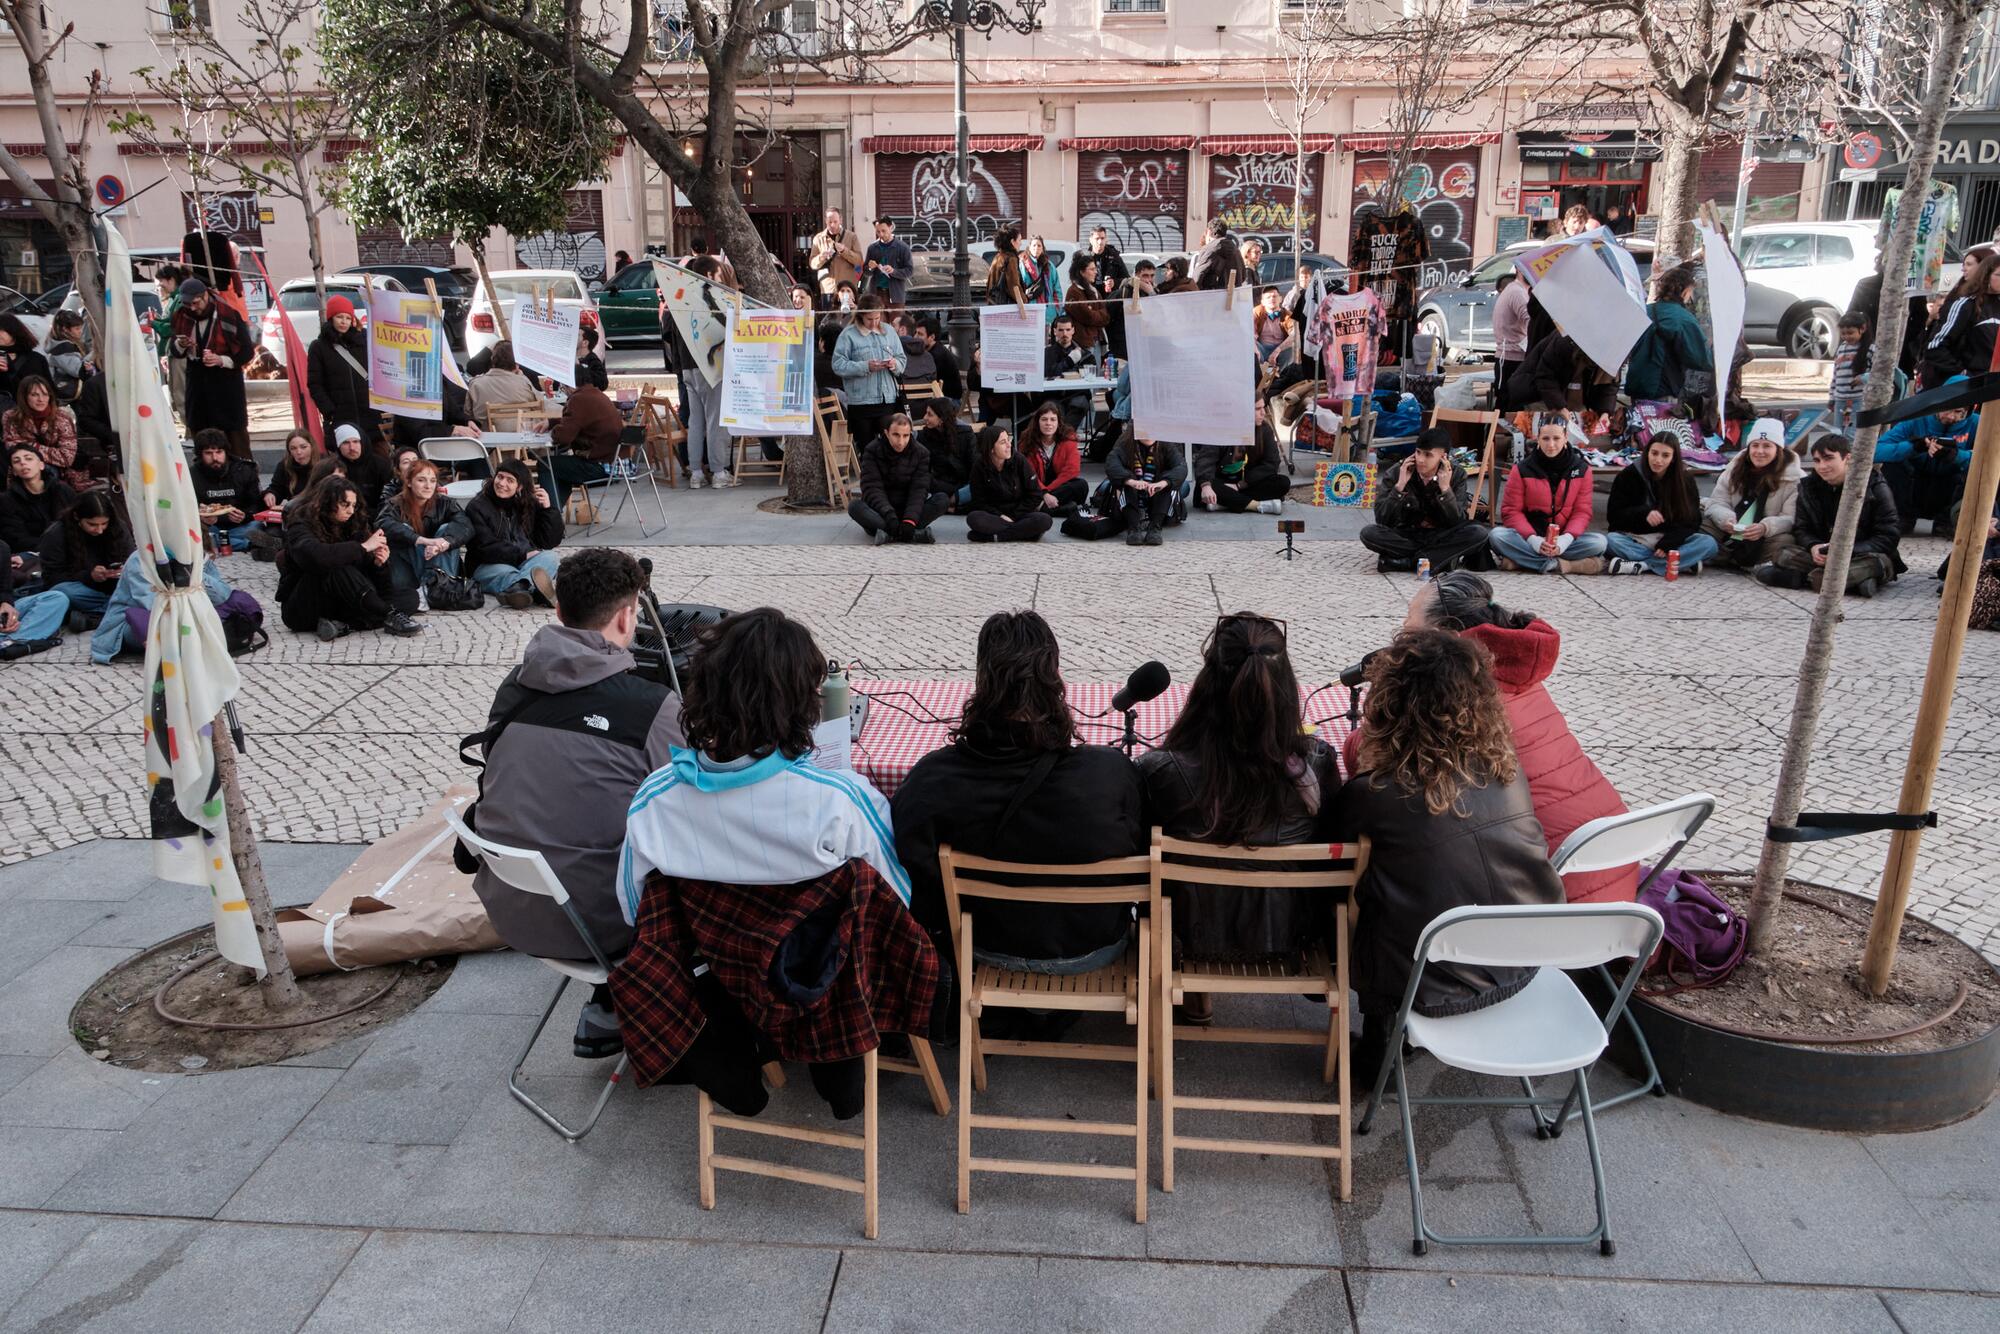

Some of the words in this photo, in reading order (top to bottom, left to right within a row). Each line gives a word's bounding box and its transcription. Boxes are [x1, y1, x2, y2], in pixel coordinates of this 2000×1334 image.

[1894, 139, 1972, 164] VRA
[1978, 139, 2000, 164] D
[1371, 234, 1399, 247] FUCK
[1370, 260, 1394, 275] HATE
[1332, 309, 1367, 321] MADRIZ
[1341, 318, 1361, 326] NO
[376, 326, 388, 340] LA
[389, 330, 429, 346] ROSA
[757, 323, 800, 338] ROSA
[1760, 432, 1768, 441] R
